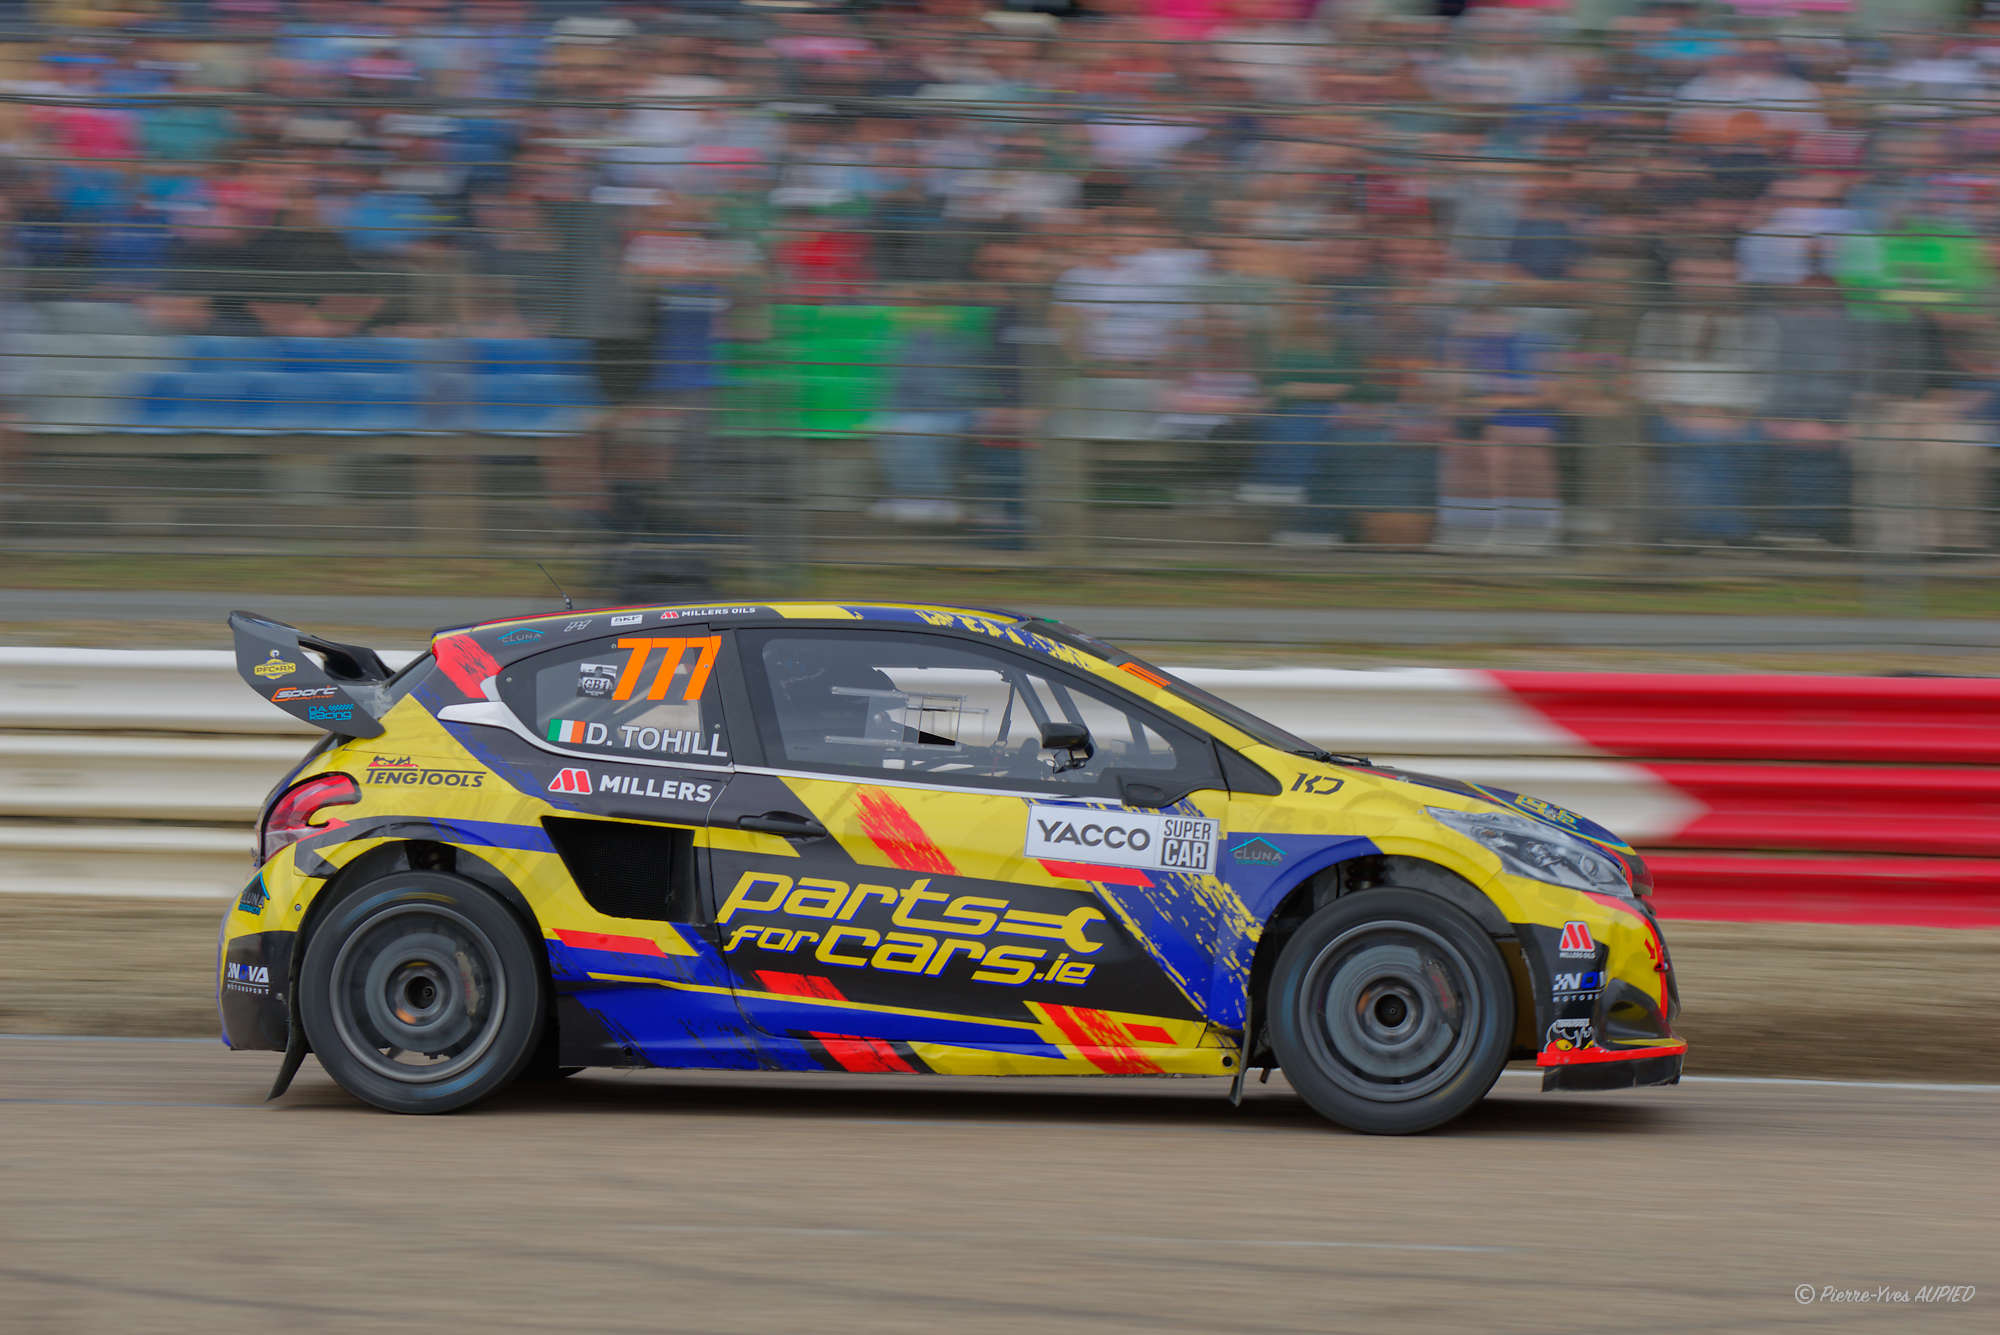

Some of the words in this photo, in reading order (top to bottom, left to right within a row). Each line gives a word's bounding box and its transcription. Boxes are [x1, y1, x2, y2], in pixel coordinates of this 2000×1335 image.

[681, 608, 729, 617] MILLERS
[612, 635, 722, 701] 777
[586, 722, 613, 746] D.
[620, 725, 728, 758] TOHILL
[599, 774, 713, 803] MILLERS
[1037, 819, 1151, 851] YACCO
[1163, 819, 1211, 841] SUPER
[1164, 839, 1208, 869] CAR
[1233, 847, 1283, 863] CLUNA
